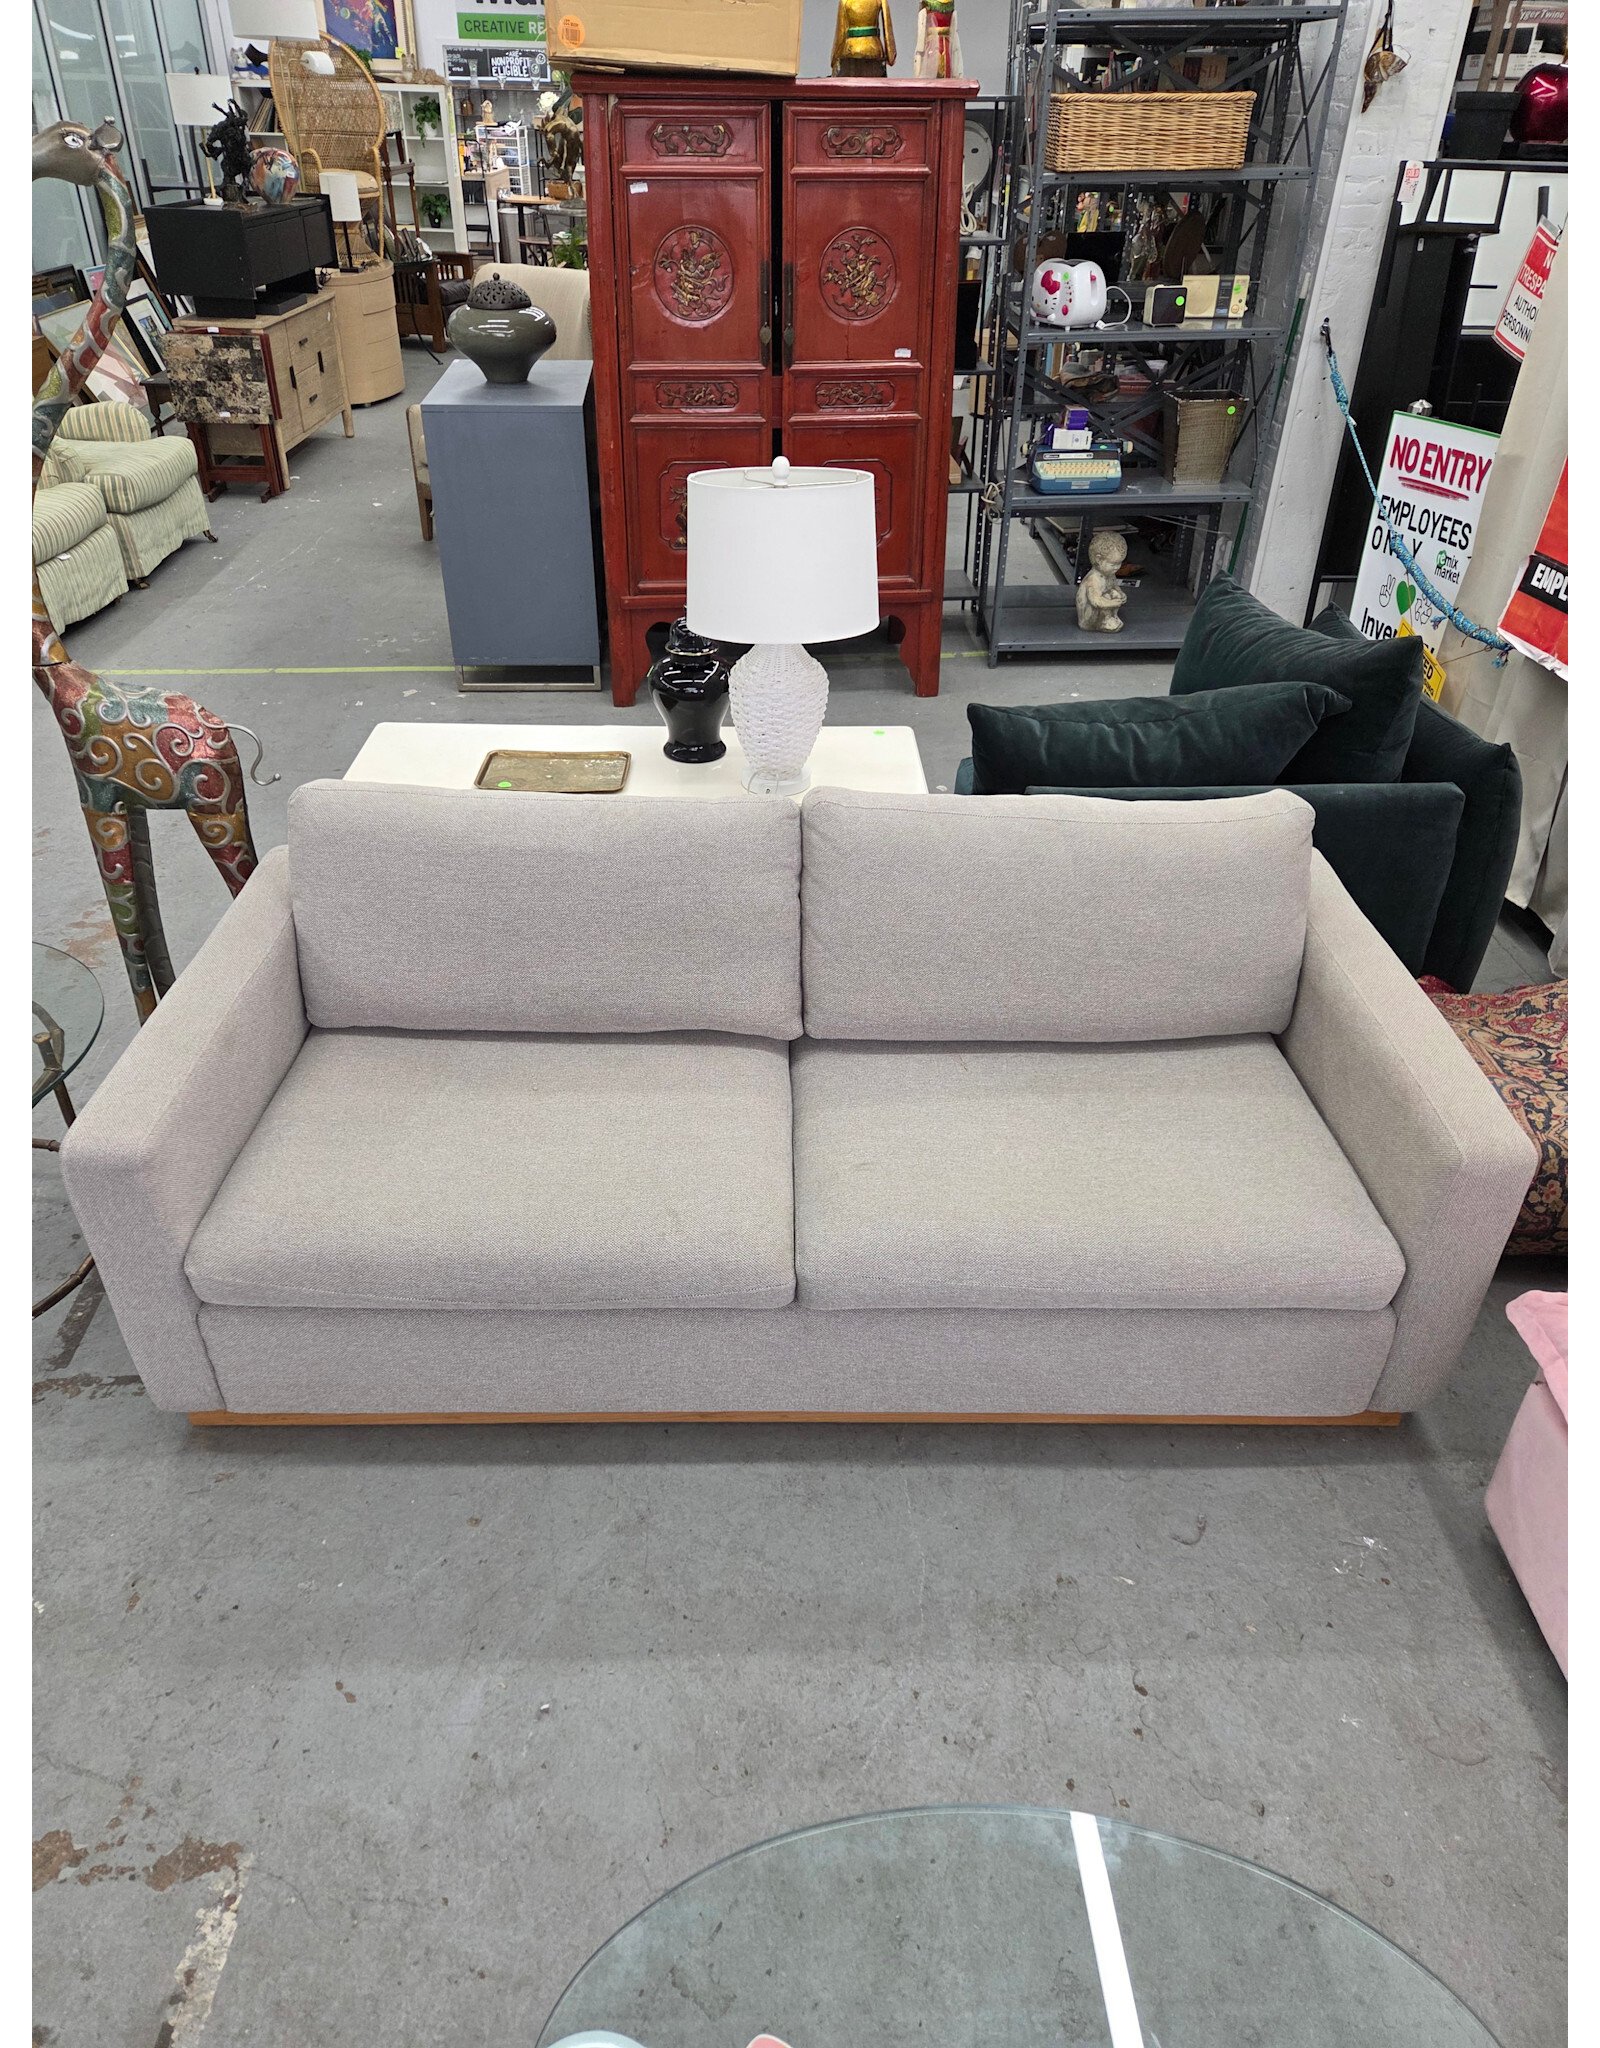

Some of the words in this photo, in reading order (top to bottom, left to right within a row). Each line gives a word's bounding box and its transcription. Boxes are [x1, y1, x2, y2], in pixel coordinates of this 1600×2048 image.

[464, 19, 526, 34] CREATIVE
[491, 56, 531, 67] NONPROFIT
[492, 66, 530, 77] ELIGIBLE
[1389, 434, 1421, 474] NO
[1419, 442, 1493, 494] ENTRY
[1377, 494, 1473, 551] EMPLOYEES
[1371, 525, 1423, 560] ONY
[1434, 564, 1461, 585] market
